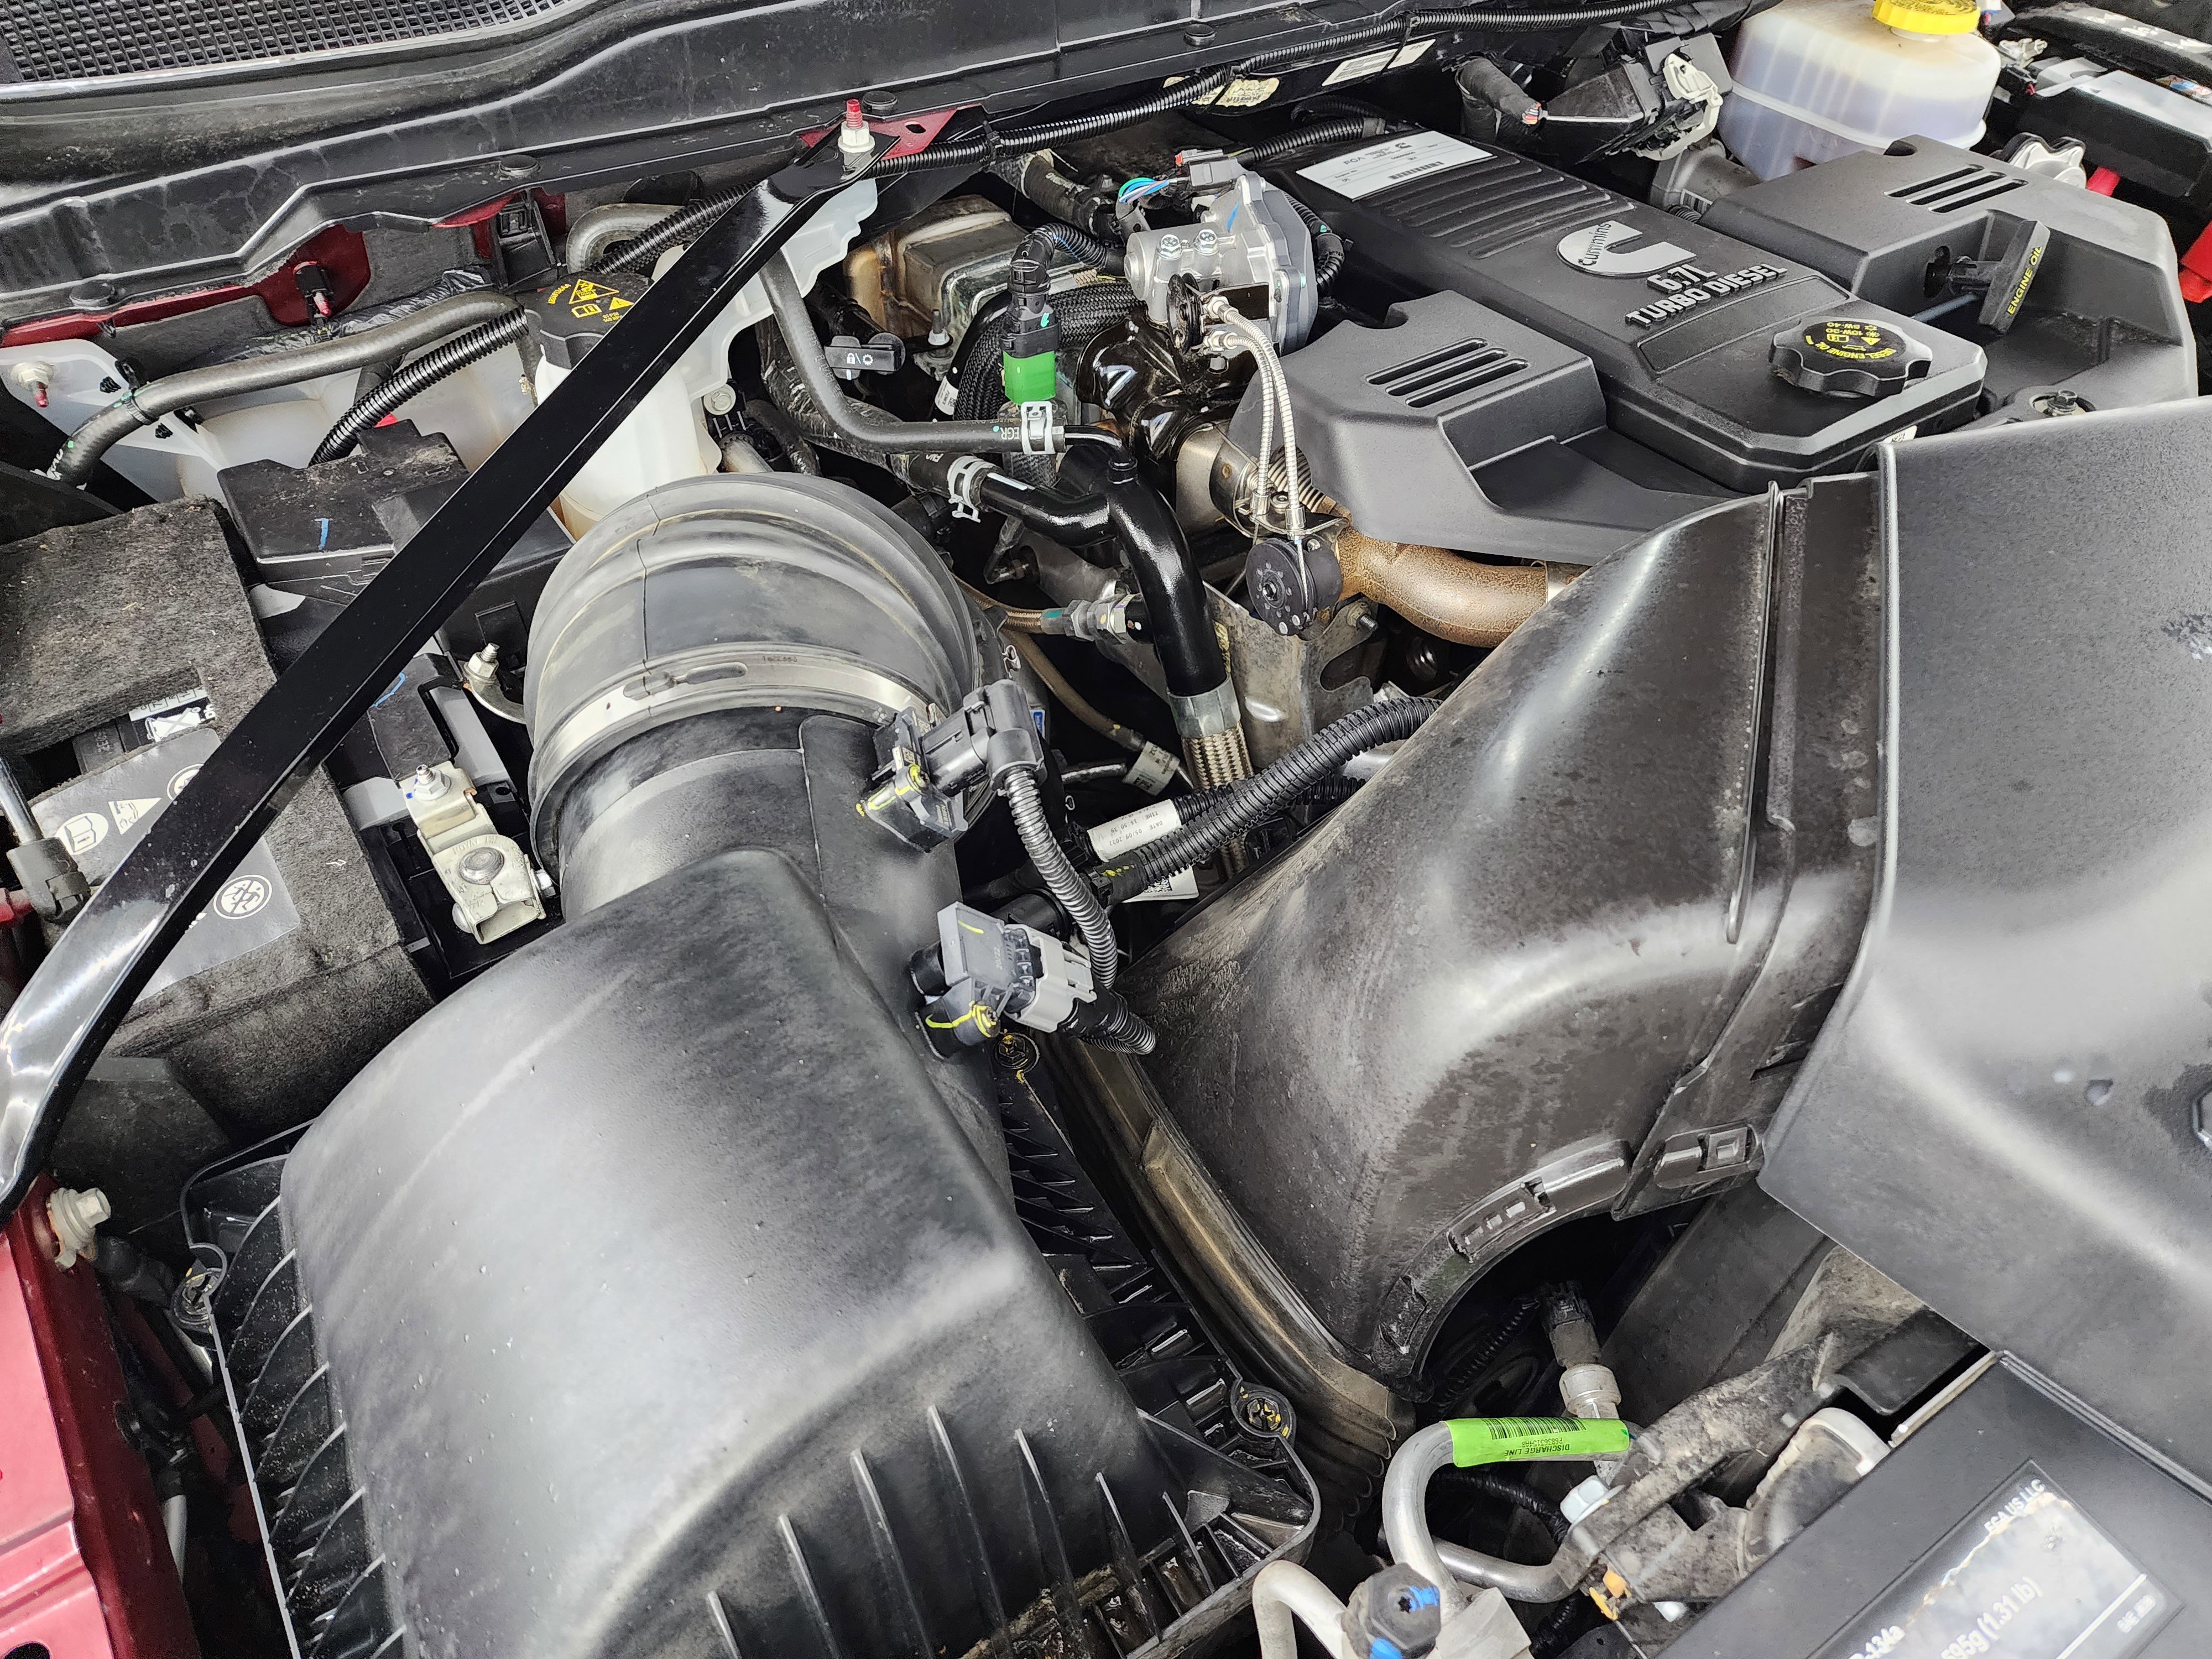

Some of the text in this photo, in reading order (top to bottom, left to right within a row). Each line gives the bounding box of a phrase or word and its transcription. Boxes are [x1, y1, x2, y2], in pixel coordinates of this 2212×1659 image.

[1578, 222, 1611, 266] Cummins
[1625, 263, 1788, 327] TURBO DIESEL
[1647, 264, 1717, 294] 6.7L
[2007, 246, 2042, 315] ENGINE OIL
[1825, 328, 1863, 336] 10W-30
[1814, 341, 1897, 359] DIESEL ENGINE OIL
[1000, 427, 1020, 440] EGR
[1504, 1444, 1570, 1457] DISCHARGE LINE
[2004, 1498, 2025, 1515] US
[2019, 1479, 2045, 1502] LLC
[1977, 1595, 2019, 1641] (1.31
[2010, 1576, 2043, 1604] lb)
